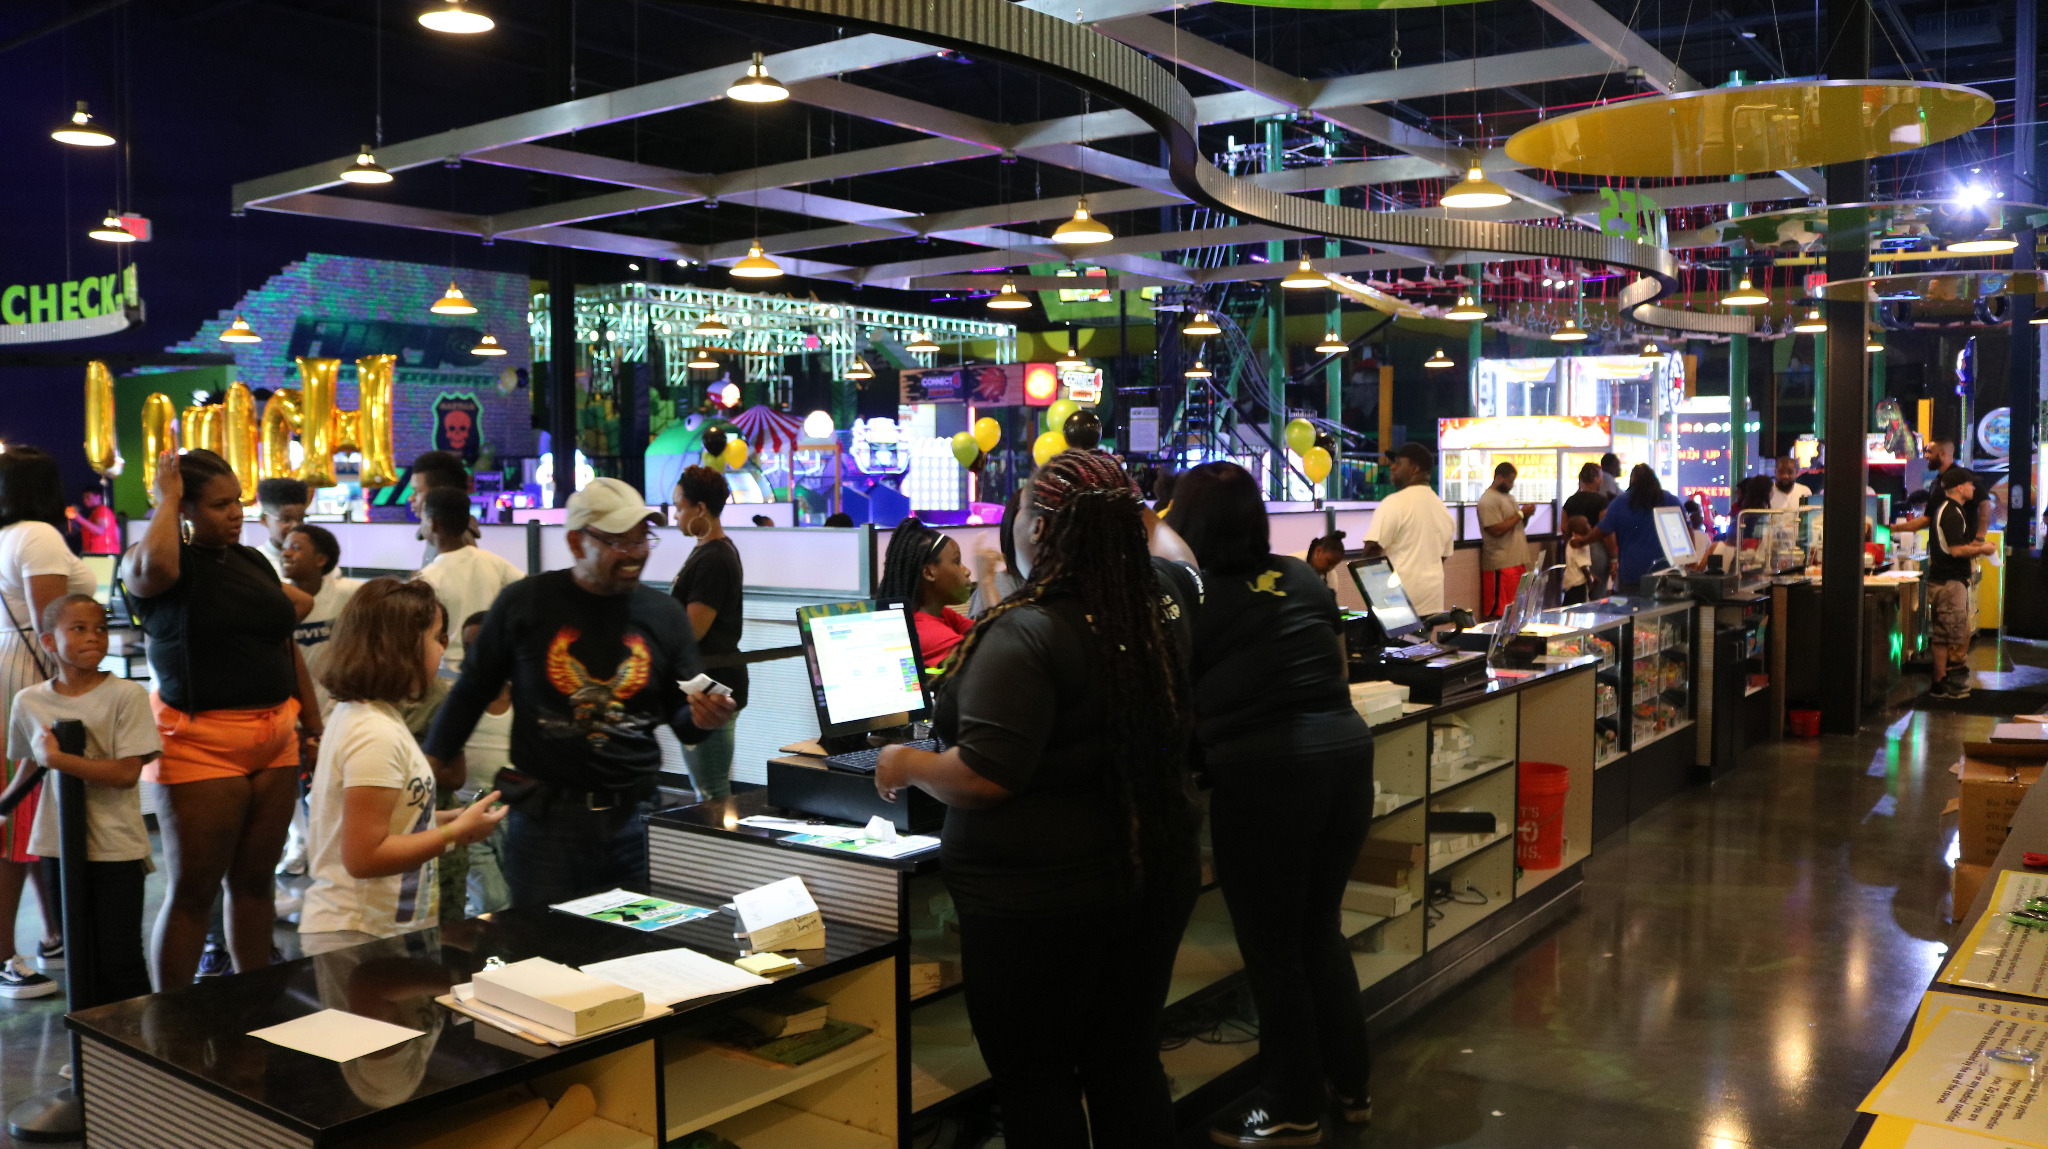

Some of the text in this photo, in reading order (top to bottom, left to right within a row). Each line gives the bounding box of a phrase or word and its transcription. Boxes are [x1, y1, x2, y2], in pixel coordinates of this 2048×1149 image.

[1515, 454, 1540, 465] WIN
[1704, 450, 1721, 460] UP
[1519, 806, 1540, 819] T'S
